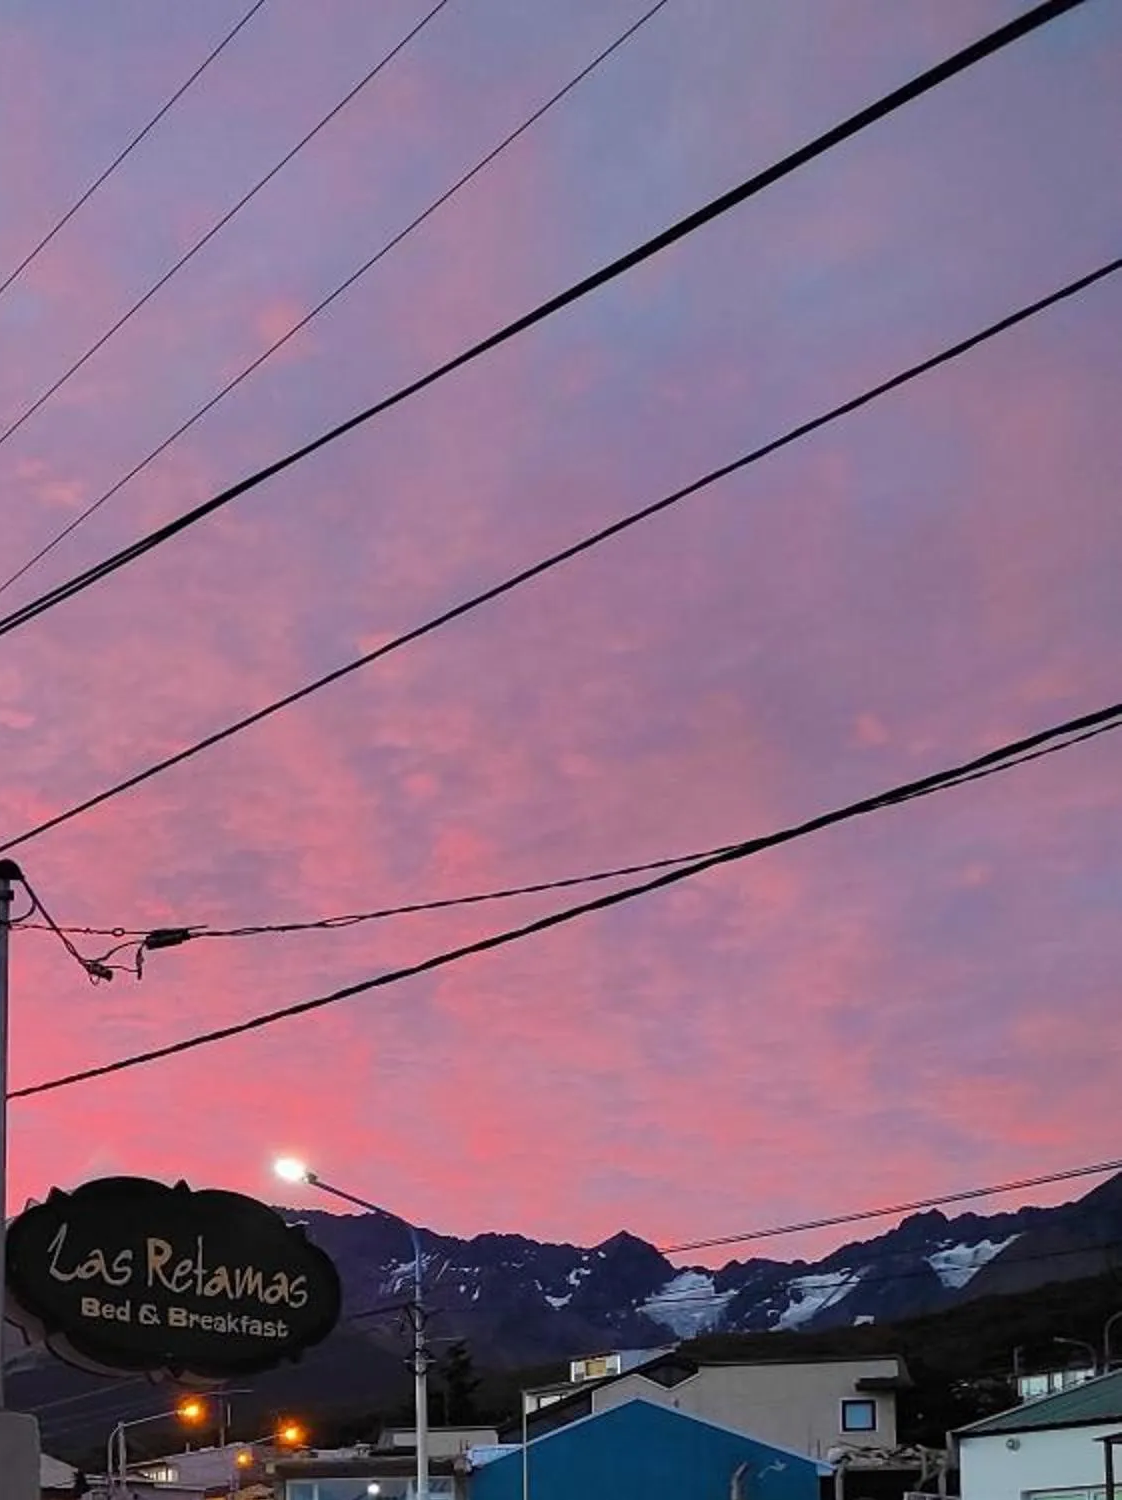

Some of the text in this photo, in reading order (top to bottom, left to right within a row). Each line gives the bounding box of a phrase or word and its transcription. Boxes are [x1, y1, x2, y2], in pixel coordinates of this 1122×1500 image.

[46, 1222, 308, 1308] Las Retamas
[81, 1297, 289, 1338] Bed & Breakfast
